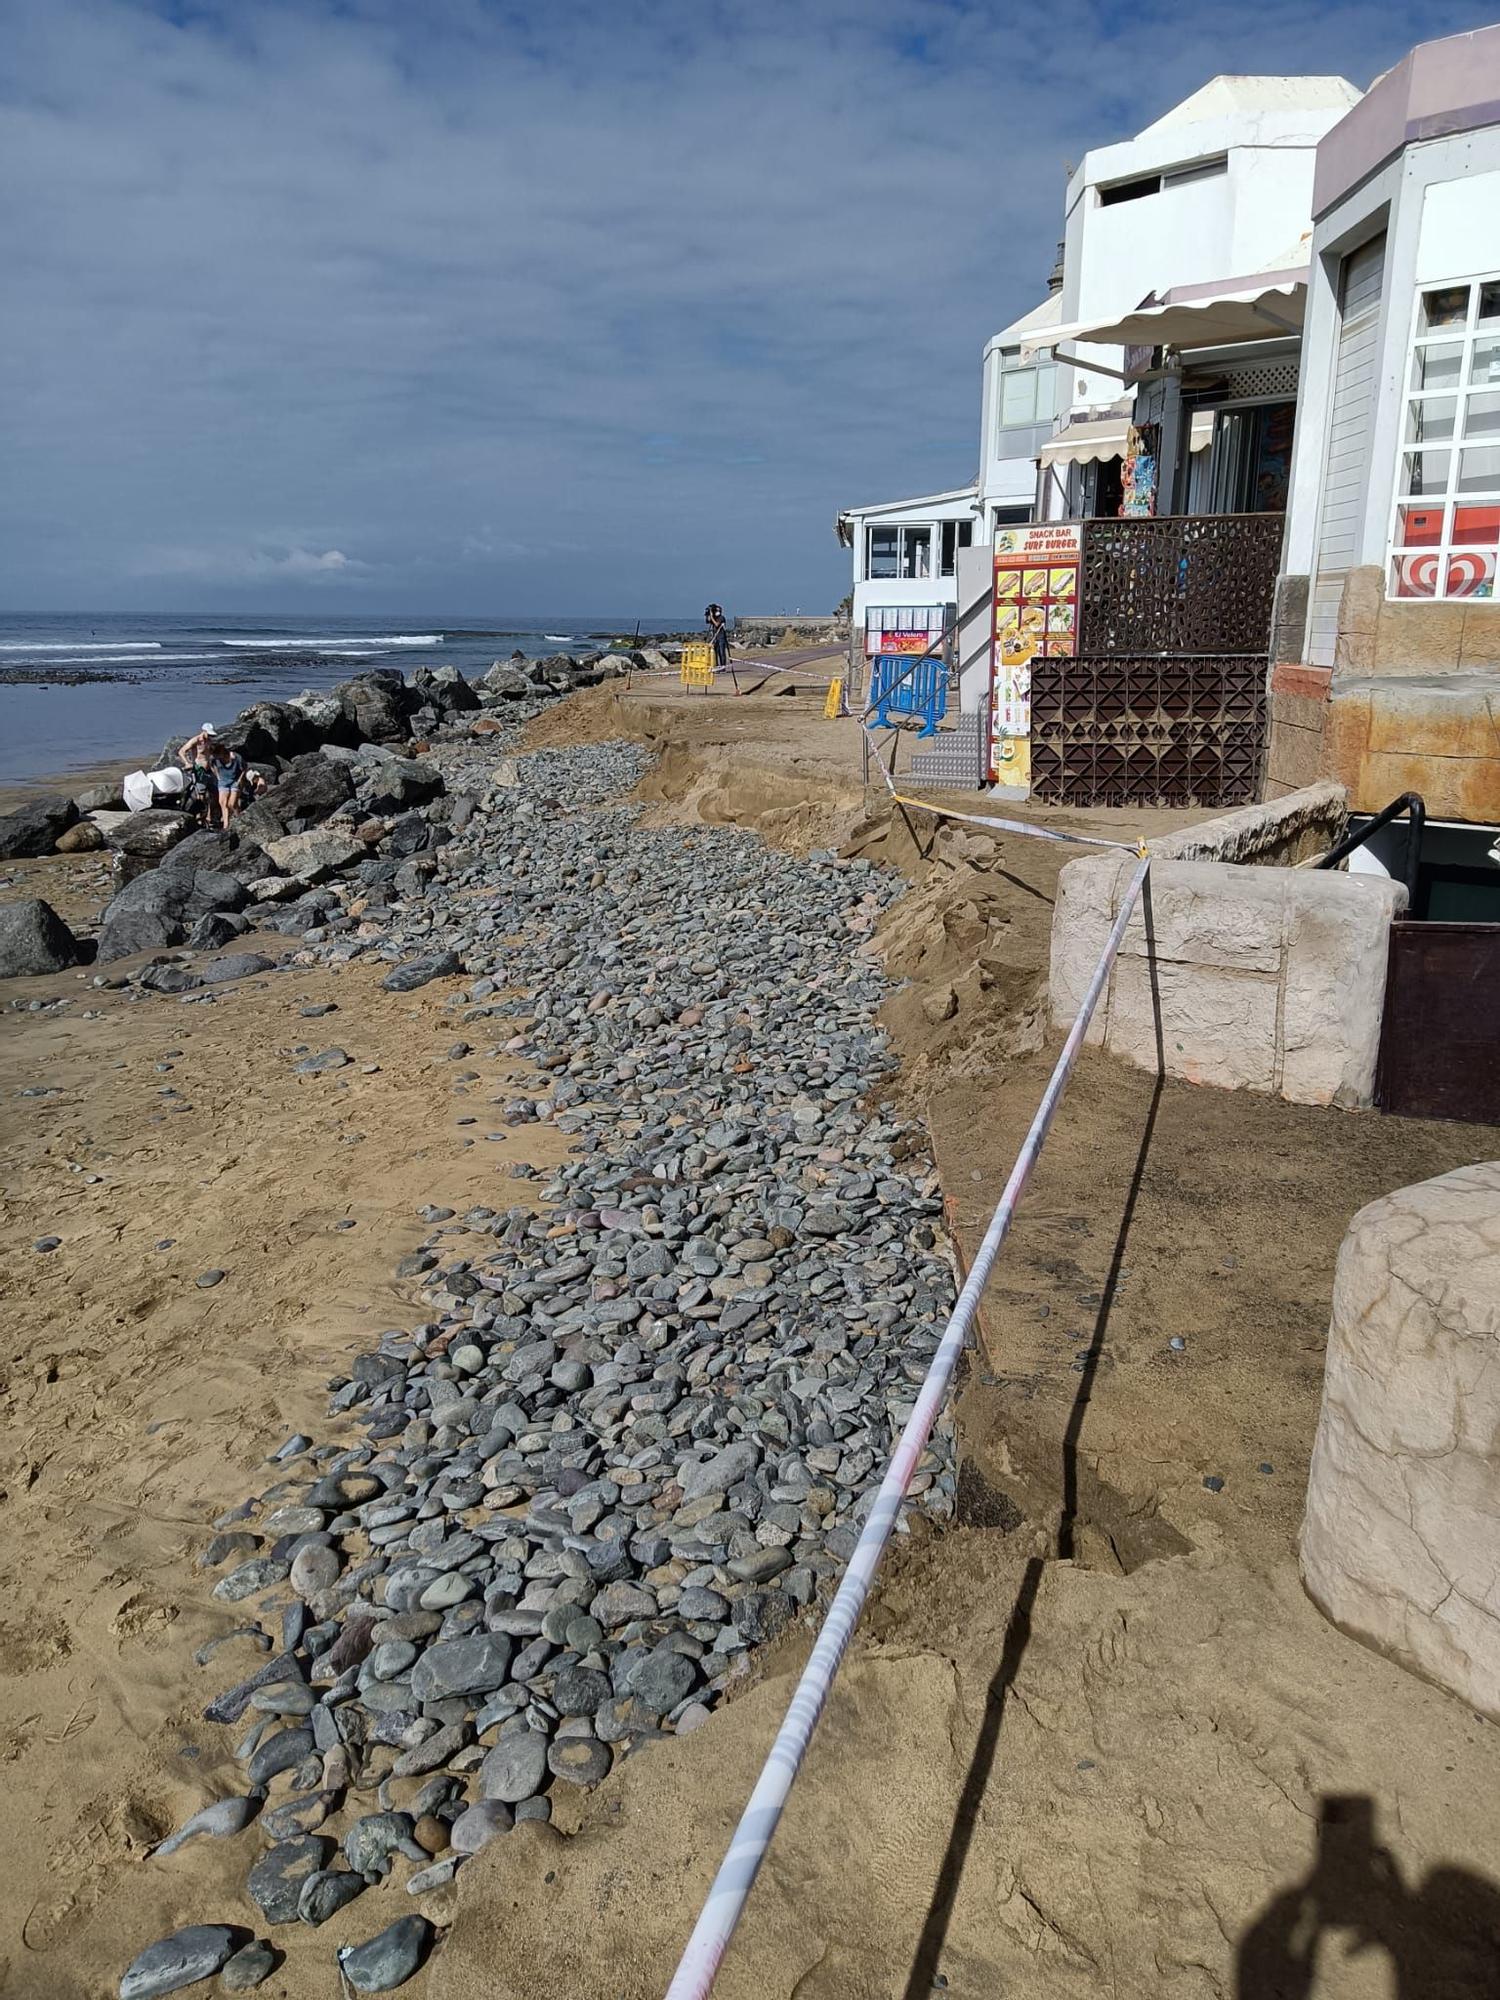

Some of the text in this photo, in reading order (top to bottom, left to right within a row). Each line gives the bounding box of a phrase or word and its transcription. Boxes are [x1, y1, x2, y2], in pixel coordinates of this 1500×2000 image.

[1029, 529, 1071, 539] SNACK BAR
[1024, 539, 1077, 550] SURF BURGER
